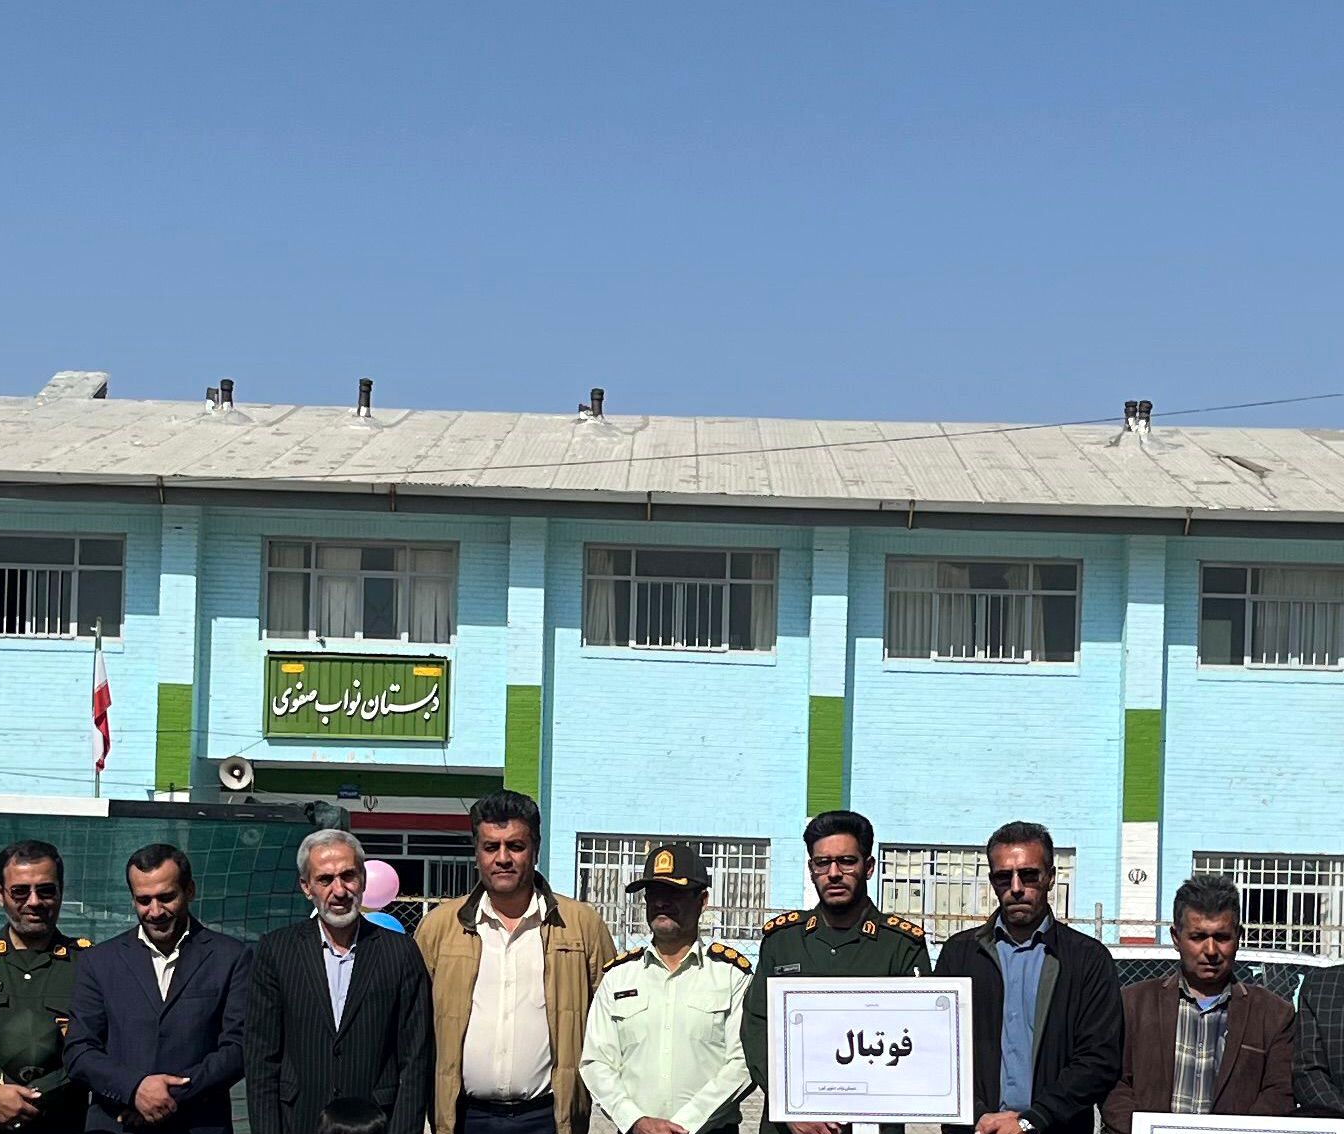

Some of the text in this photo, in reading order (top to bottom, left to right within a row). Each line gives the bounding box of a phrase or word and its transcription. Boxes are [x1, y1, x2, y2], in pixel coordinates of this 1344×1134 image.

[272, 679, 440, 724] دبستان نواب صفوی
[835, 1027, 913, 1067] فوتبال
